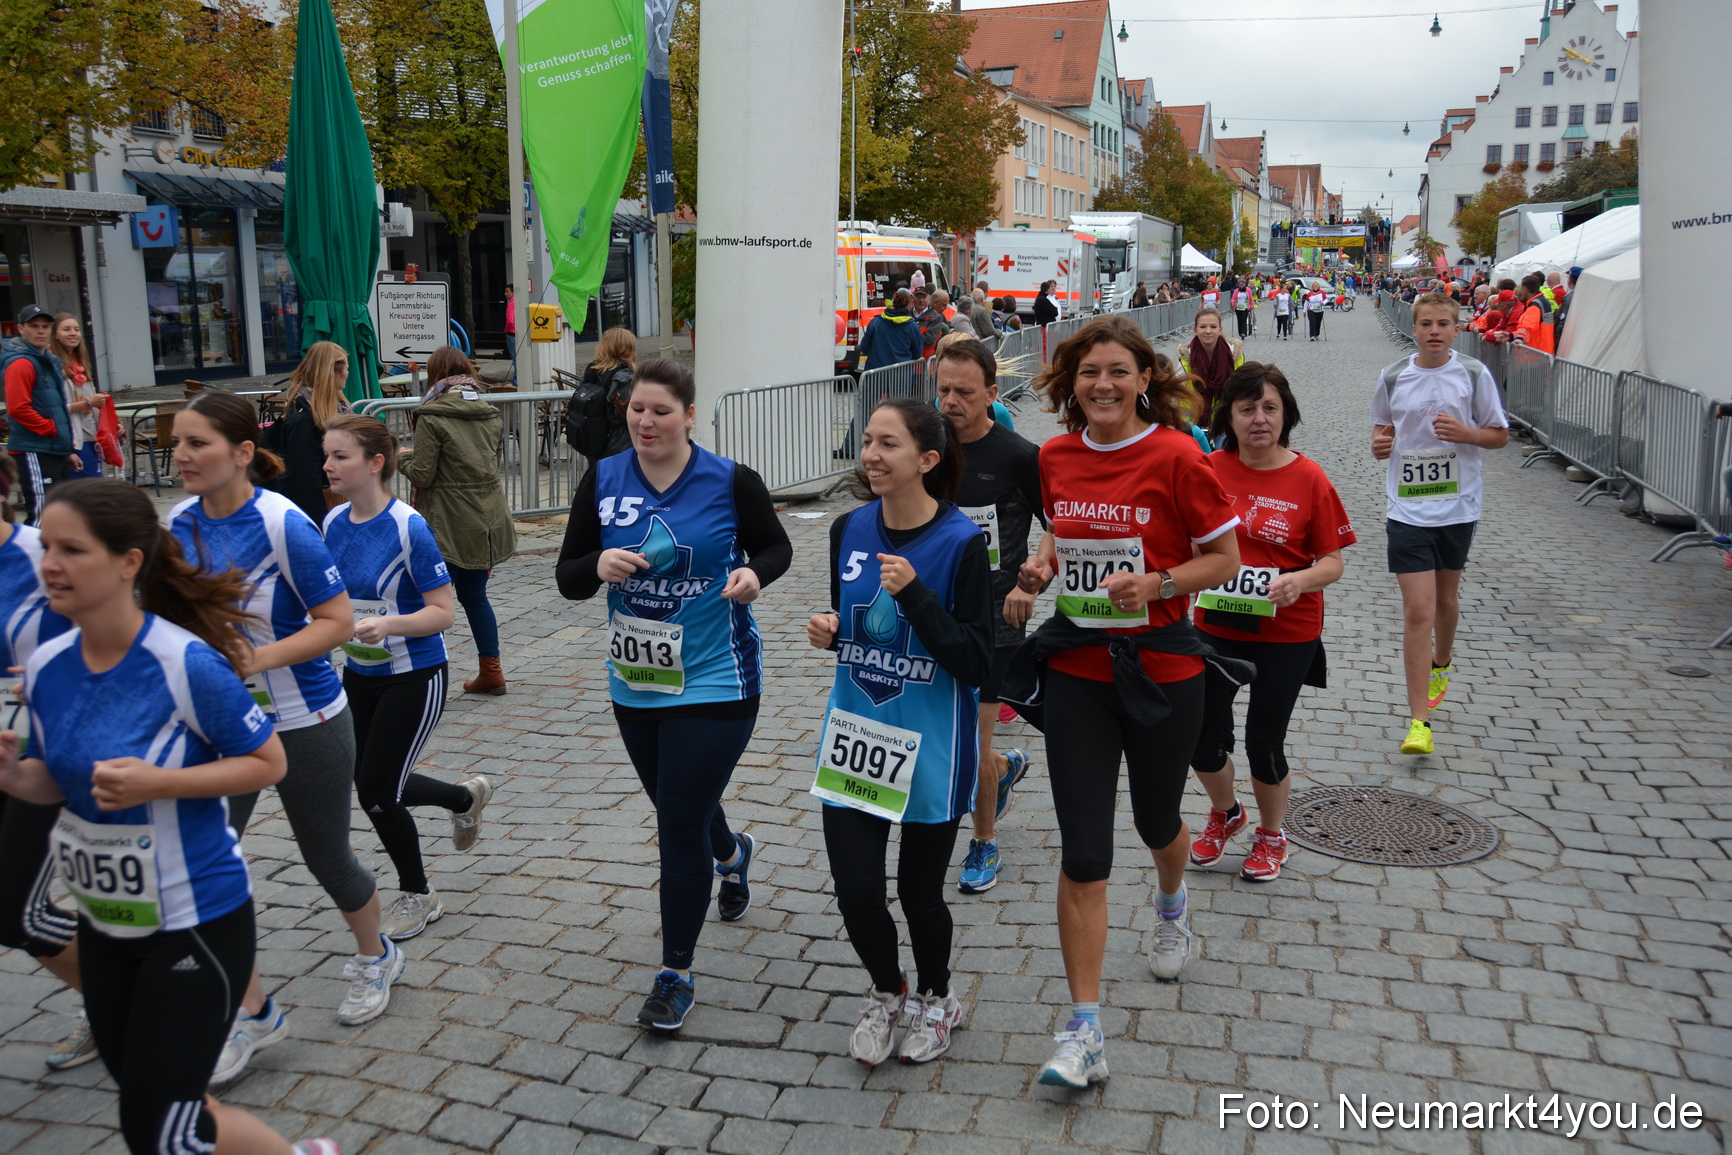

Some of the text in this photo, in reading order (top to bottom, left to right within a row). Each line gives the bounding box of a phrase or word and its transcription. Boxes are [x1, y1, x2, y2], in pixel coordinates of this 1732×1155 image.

[537, 53, 635, 88] Genuss schaffen.
[183, 146, 212, 169] City
[699, 236, 813, 249] www.bmw-laufsport.de
[380, 291, 445, 301] Fußgänger Richtung
[391, 302, 434, 310] Lammsbräu-
[389, 311, 437, 321] Kreuzung über
[402, 322, 425, 330] Untere
[393, 332, 436, 341] Kaserngasse
[1403, 461, 1450, 483] 5131
[1407, 485, 1448, 496] Alexander
[1254, 500, 1289, 513] STADTLAUF
[1256, 495, 1299, 511] NEUMARKTER
[598, 496, 645, 527] 45
[1089, 523, 1130, 533] STARKE STADT
[1056, 546, 1126, 557] PARTL Neumarkt
[841, 550, 869, 582] 5
[1065, 560, 1135, 593] 504
[1208, 569, 1272, 597] 063
[630, 596, 674, 609] BASKETS
[1081, 601, 1112, 616] Anita
[1216, 598, 1253, 613] Christa
[628, 624, 667, 638] Neumarkt
[610, 630, 674, 668] 5013
[837, 642, 935, 680] IBALON
[627, 669, 655, 681] Julia
[858, 670, 899, 688] BASKETS
[830, 717, 903, 747] PARTL Neumarkt
[830, 732, 908, 785] 5097
[843, 778, 878, 801] Maria
[59, 841, 145, 896] 5059
